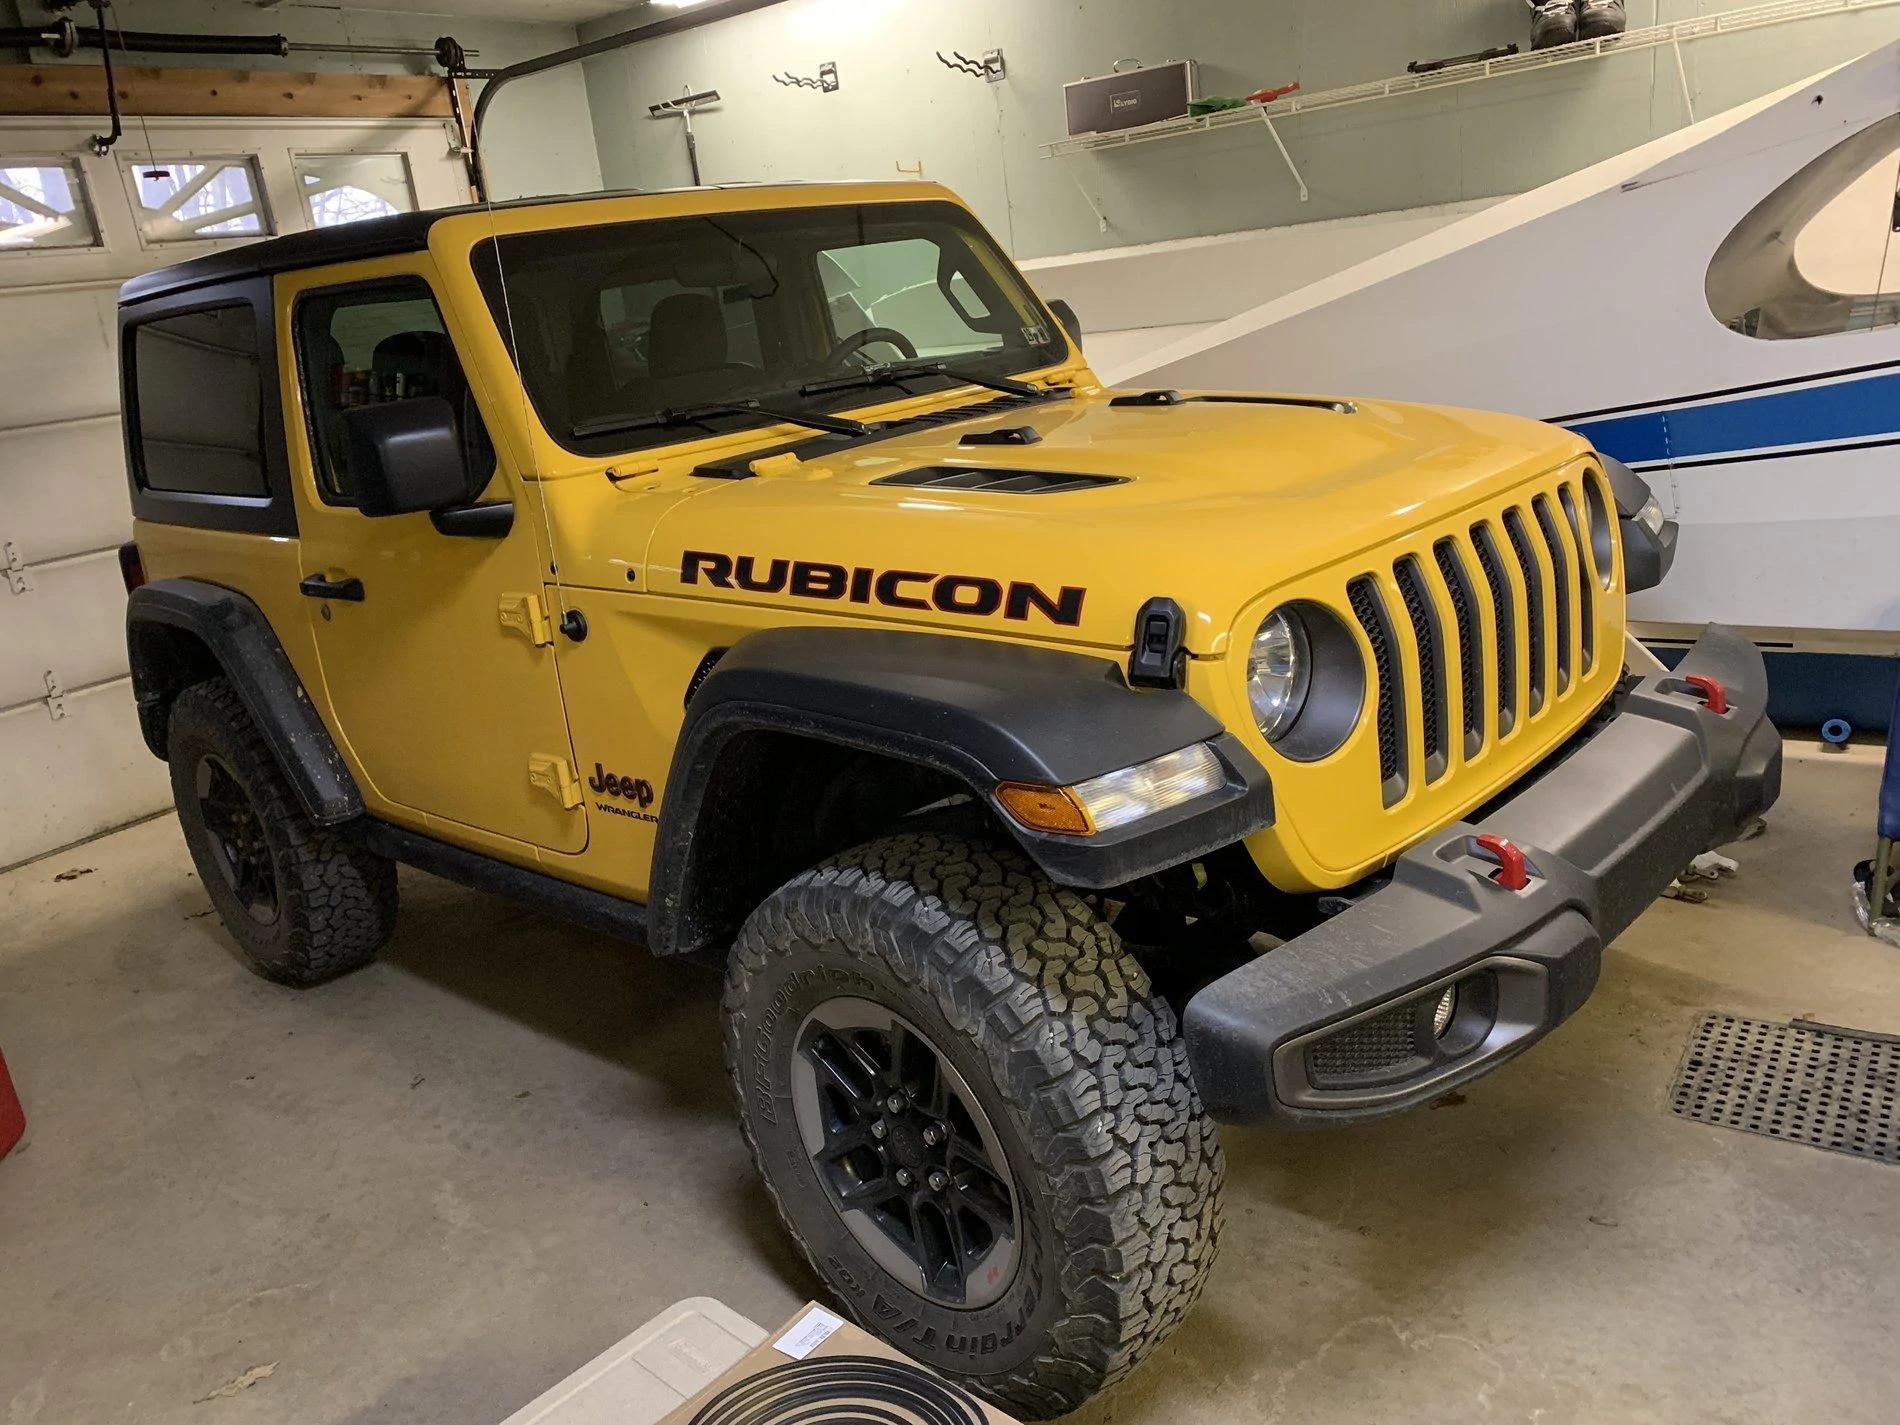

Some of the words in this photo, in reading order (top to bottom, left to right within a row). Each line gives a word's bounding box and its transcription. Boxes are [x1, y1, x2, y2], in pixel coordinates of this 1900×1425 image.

[680, 550, 1087, 627] RUBICON
[588, 763, 654, 808] Jeep
[595, 802, 659, 823] WRANGLER
[752, 964, 876, 1125] BFGoodrich
